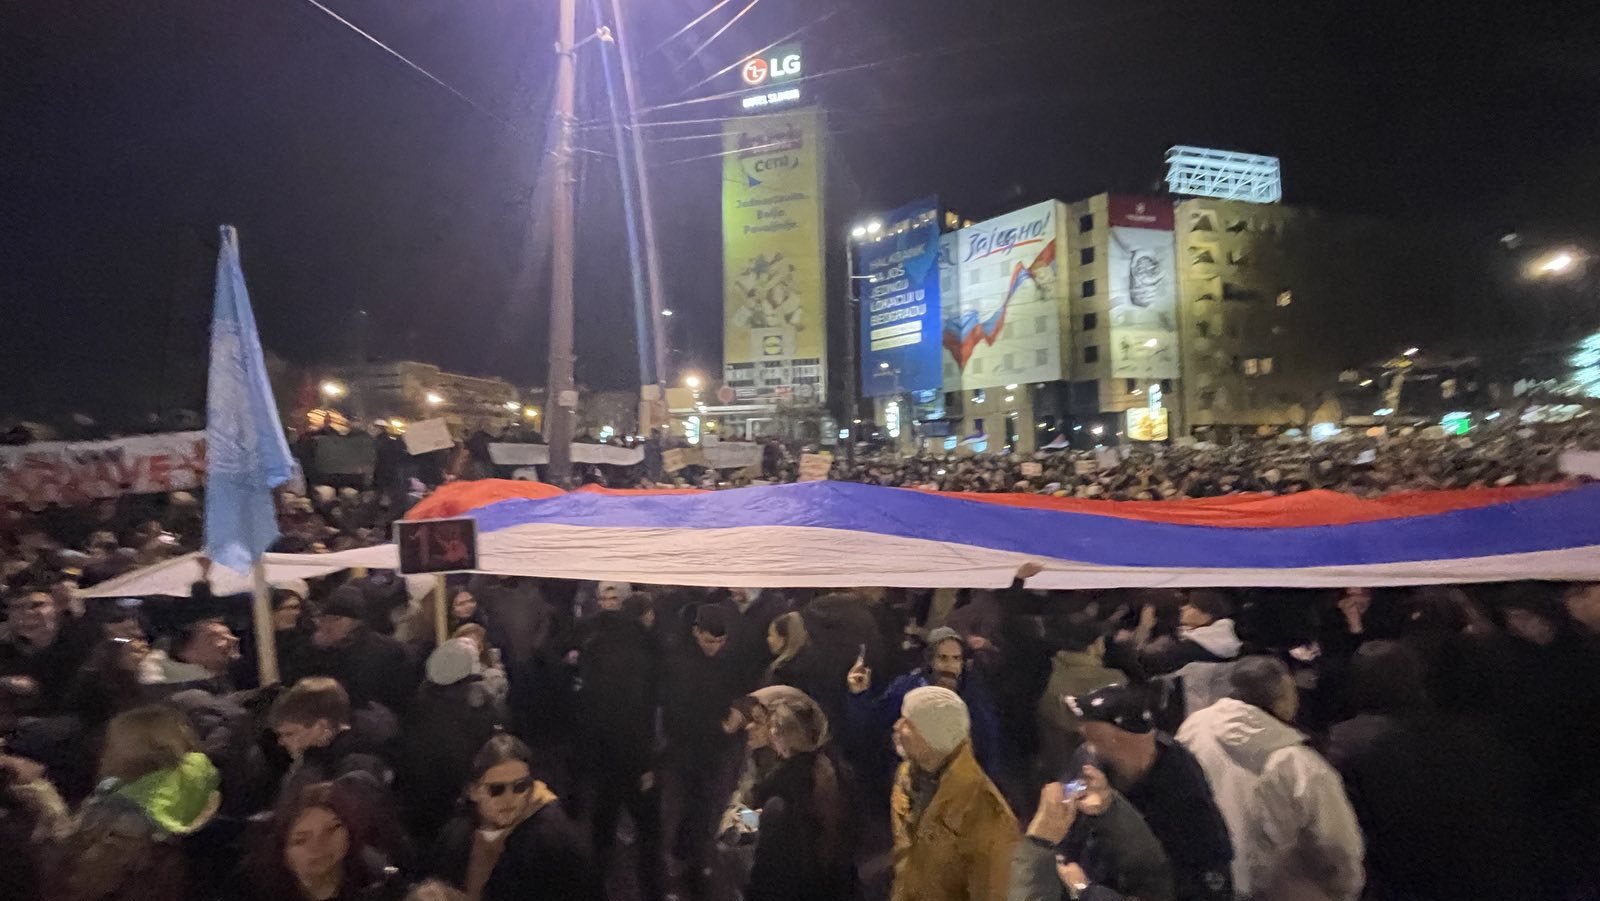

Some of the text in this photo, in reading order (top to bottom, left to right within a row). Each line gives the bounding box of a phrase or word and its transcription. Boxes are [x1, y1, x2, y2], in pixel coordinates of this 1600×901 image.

[770, 54, 801, 78] LG
[963, 210, 1052, 263] Заједно!
[914, 288, 925, 301] U
